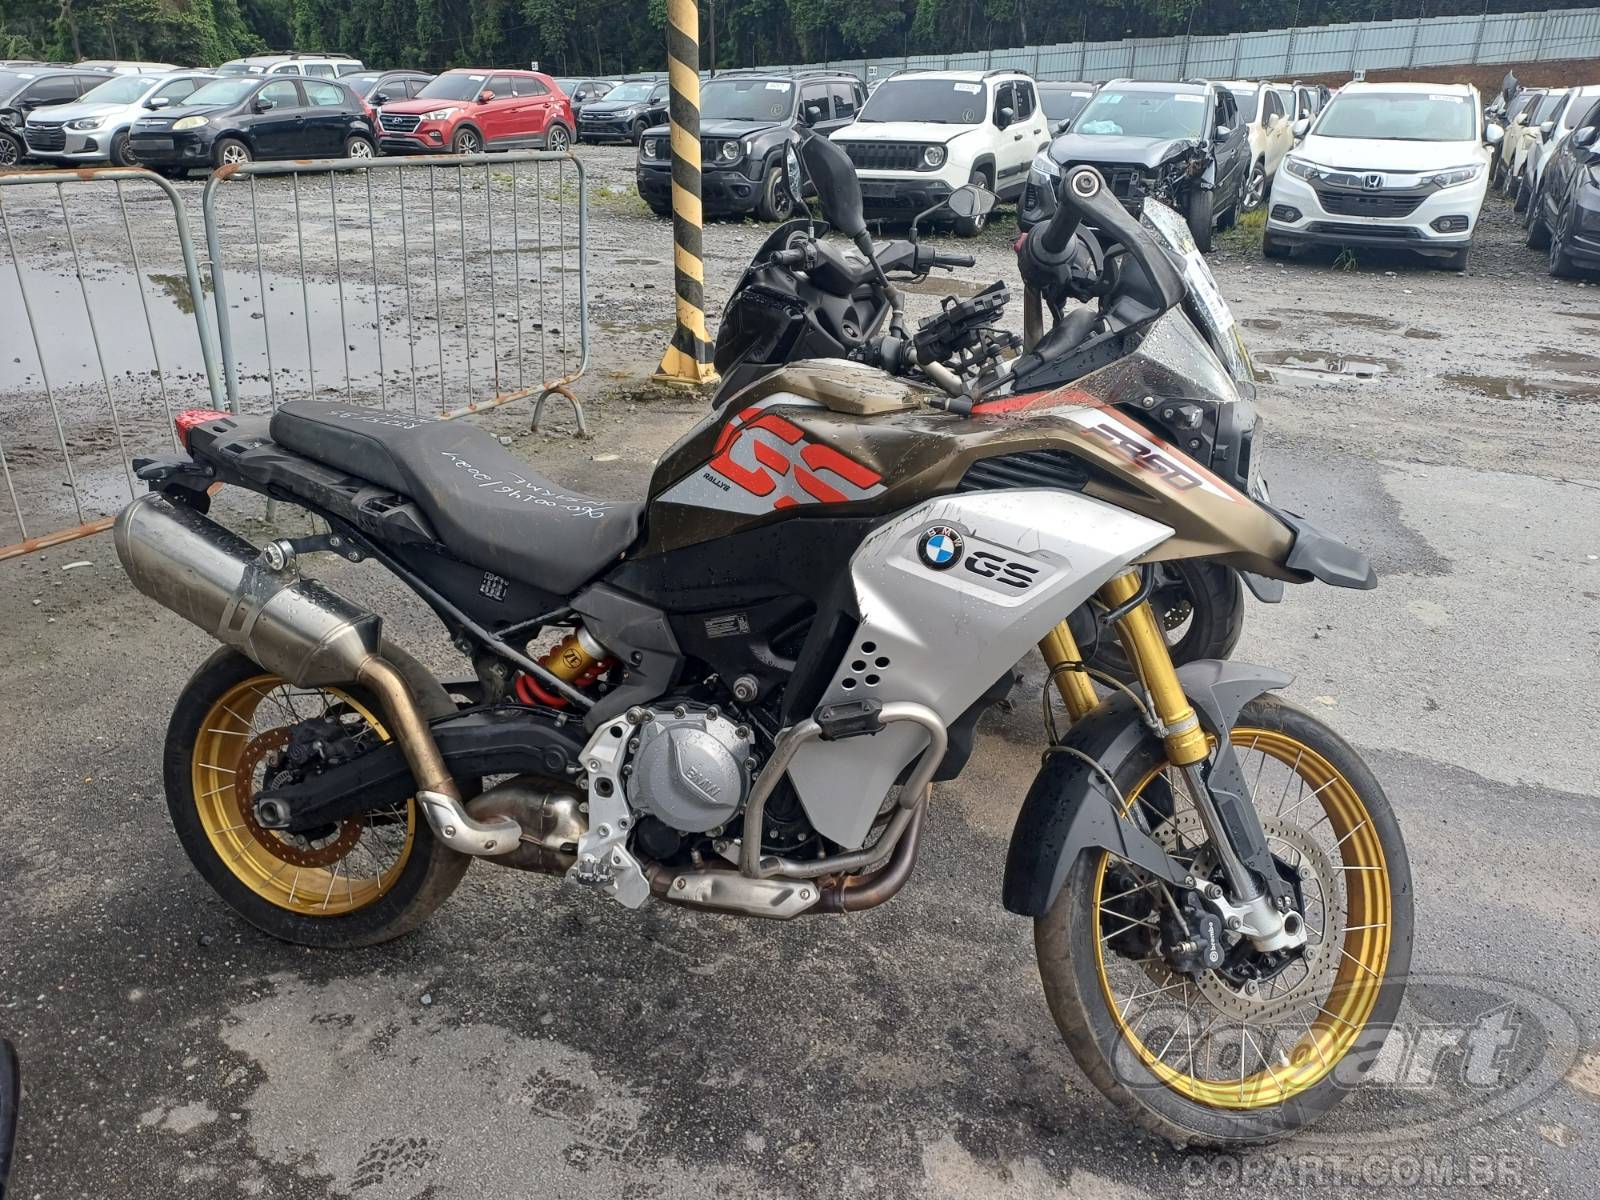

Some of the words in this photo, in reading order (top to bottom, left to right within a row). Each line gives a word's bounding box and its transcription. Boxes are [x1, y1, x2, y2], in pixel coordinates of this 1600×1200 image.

[927, 526, 962, 547] BMW
[965, 551, 1039, 588] GS
[564, 649, 581, 668] ZF
[686, 766, 721, 798] BMW
[1208, 921, 1217, 951] brembo
